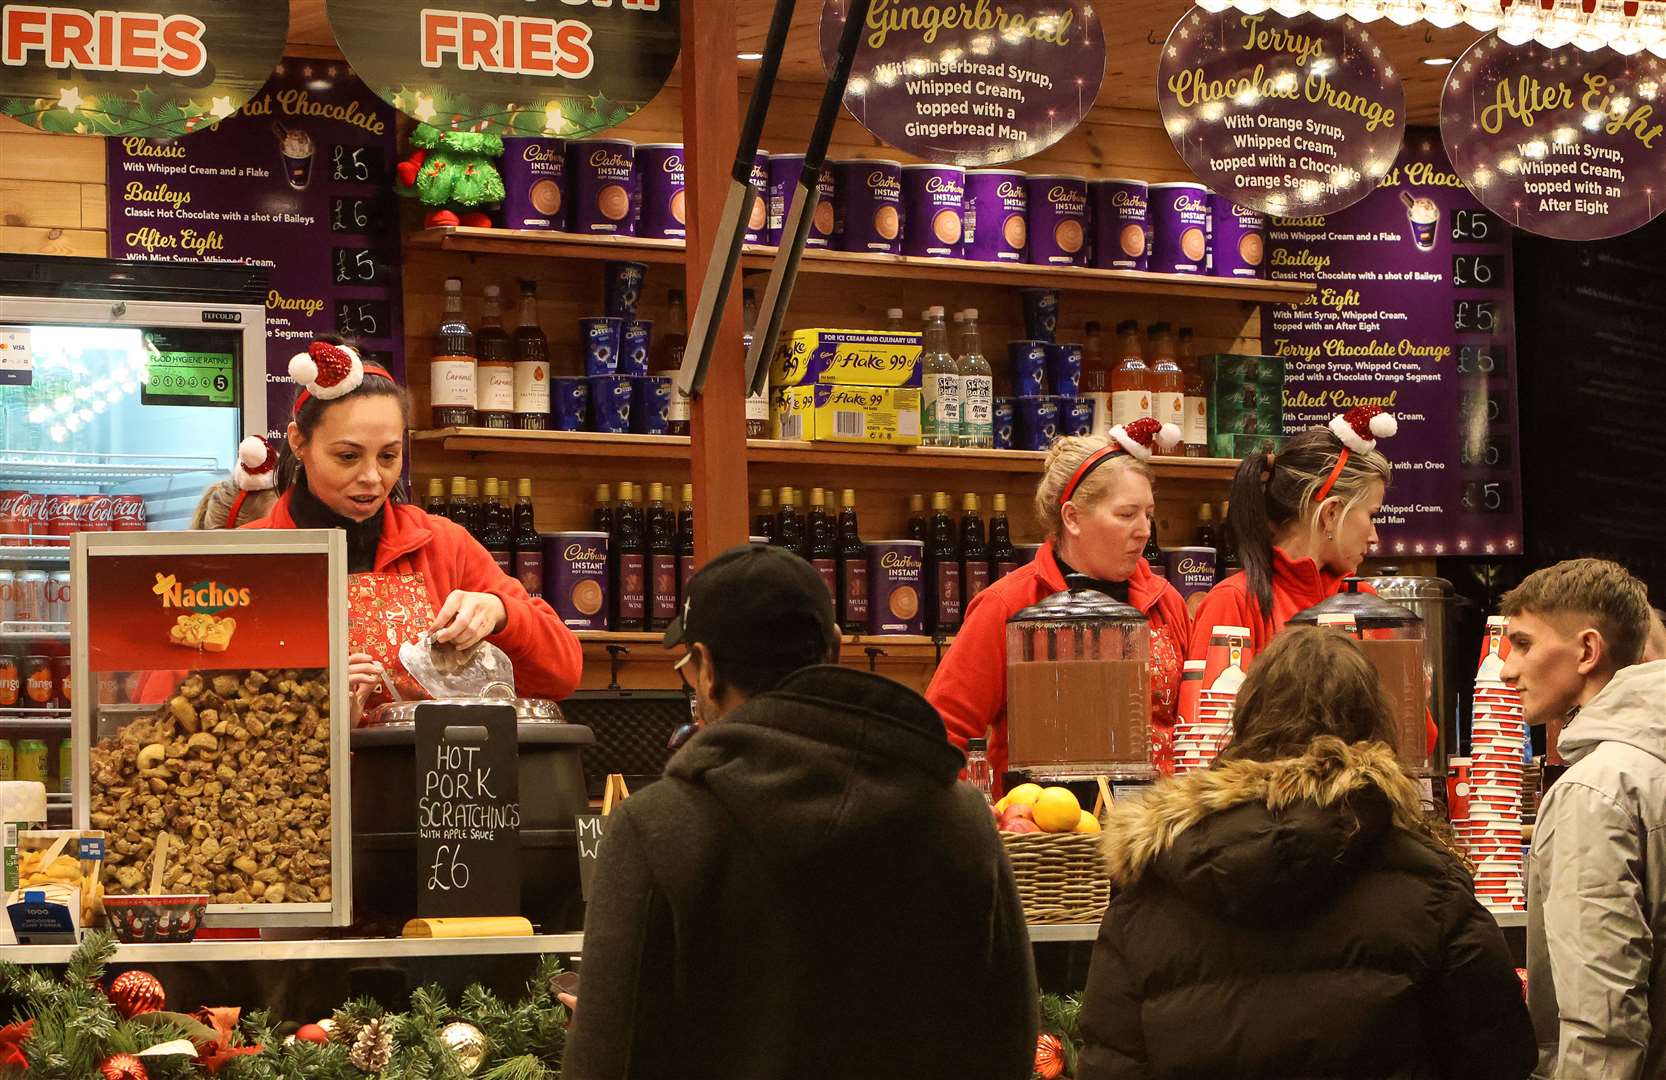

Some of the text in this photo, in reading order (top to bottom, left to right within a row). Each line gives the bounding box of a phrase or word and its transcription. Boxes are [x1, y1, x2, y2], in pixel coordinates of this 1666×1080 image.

[866, 0, 1074, 49] Gingerbread
[2, 5, 207, 77] FRIES
[420, 9, 594, 80] FRIES
[1241, 15, 1324, 66] Terrys
[912, 60, 1052, 90] Gingerbread Syrup,
[906, 80, 1025, 103] Whipped Cream,
[1168, 64, 1395, 132] Chocolate Orange
[277, 89, 385, 135] Chocolate
[916, 101, 1016, 120] topped with a
[1481, 72, 1665, 149] After Eight
[905, 121, 1028, 142] Gingerbread Man
[1224, 114, 1345, 141] With Orange Syrup,
[123, 136, 187, 158] Classic
[1233, 135, 1337, 158] Whipped Cream,
[1552, 143, 1624, 164] Mint Syrup,
[123, 162, 269, 178] With Whipped Cream and a Flake
[333, 145, 369, 181] £5
[589, 150, 633, 172] Cadbury
[1210, 155, 1361, 182] topped with a Chocolate
[598, 168, 630, 177] INSTANT
[1519, 161, 1625, 183] Whipped Cream,
[124, 181, 191, 210] Baileys
[1235, 174, 1339, 196] Orange Segment
[1524, 180, 1621, 198] topped with an
[933, 194, 962, 203] INSTANT
[1055, 203, 1084, 212] INSTANT
[1539, 199, 1609, 215] After Eight
[125, 207, 315, 225] Classic Hot Chocolate with a shot of Baileys
[333, 200, 368, 231] £6
[1452, 210, 1488, 240] £5
[126, 227, 224, 256] After Eight
[1270, 231, 1289, 241] With
[1290, 232, 1327, 243] Whipped
[1328, 232, 1354, 242] Cream
[1356, 233, 1371, 242] and
[1380, 233, 1402, 242] Flake
[245, 257, 276, 268] Cream,
[336, 250, 375, 283] £5
[1270, 248, 1331, 272] Baileys
[1271, 271, 1298, 280] Classic
[1299, 271, 1315, 280] Hot
[1316, 271, 1357, 281] Chocolate
[1358, 272, 1377, 281] with
[1384, 272, 1403, 281] shot
[1404, 272, 1413, 281] of
[1414, 272, 1443, 283] Baileys
[1453, 256, 1492, 286] £6
[1321, 288, 1360, 313] Eight
[1273, 311, 1408, 322] With Mint Syrup, Whipped Cream,
[1455, 302, 1494, 331] £5
[274, 328, 314, 342] Segment
[1273, 322, 1302, 333] topped
[1304, 322, 1323, 331] with
[1336, 322, 1357, 331] After
[1359, 322, 1380, 332] Eight
[151, 355, 171, 363] FOOD
[204, 357, 229, 365] RATING
[841, 352, 907, 370] flake 99
[1274, 339, 1451, 362] Terrys Chocolate Orange
[1297, 362, 1421, 373] Orange Syrup, Whipped Cream,
[1306, 373, 1324, 381] with
[1333, 373, 1373, 382] Chocolate
[1374, 373, 1404, 384] Orange
[1405, 373, 1441, 384] Segment
[833, 392, 882, 406] flake 99
[1281, 389, 1328, 408] Salted
[1329, 390, 1397, 407] Caramel
[1297, 412, 1331, 421] Caramel
[1397, 412, 1426, 422] Cream,
[1394, 461, 1412, 470] with
[1425, 461, 1445, 470] Oreo
[1380, 504, 1443, 515] Whipped Cream,
[1388, 516, 1405, 524] Man
[564, 544, 607, 564] Cadbury
[881, 551, 922, 570] Cadbury
[572, 561, 604, 570] INSTANT
[888, 569, 919, 577] INSTANT
[1178, 557, 1216, 576] Cadbury
[1185, 574, 1213, 582] INSTANT
[162, 581, 251, 608] Nachos
[27, 678, 53, 690] Tango
[437, 744, 481, 773] HOT
[425, 767, 497, 800] PORK
[419, 797, 521, 830] SCRATCHINGS
[420, 828, 495, 841] WITH APPLE SAUCE
[427, 843, 470, 891] £6
